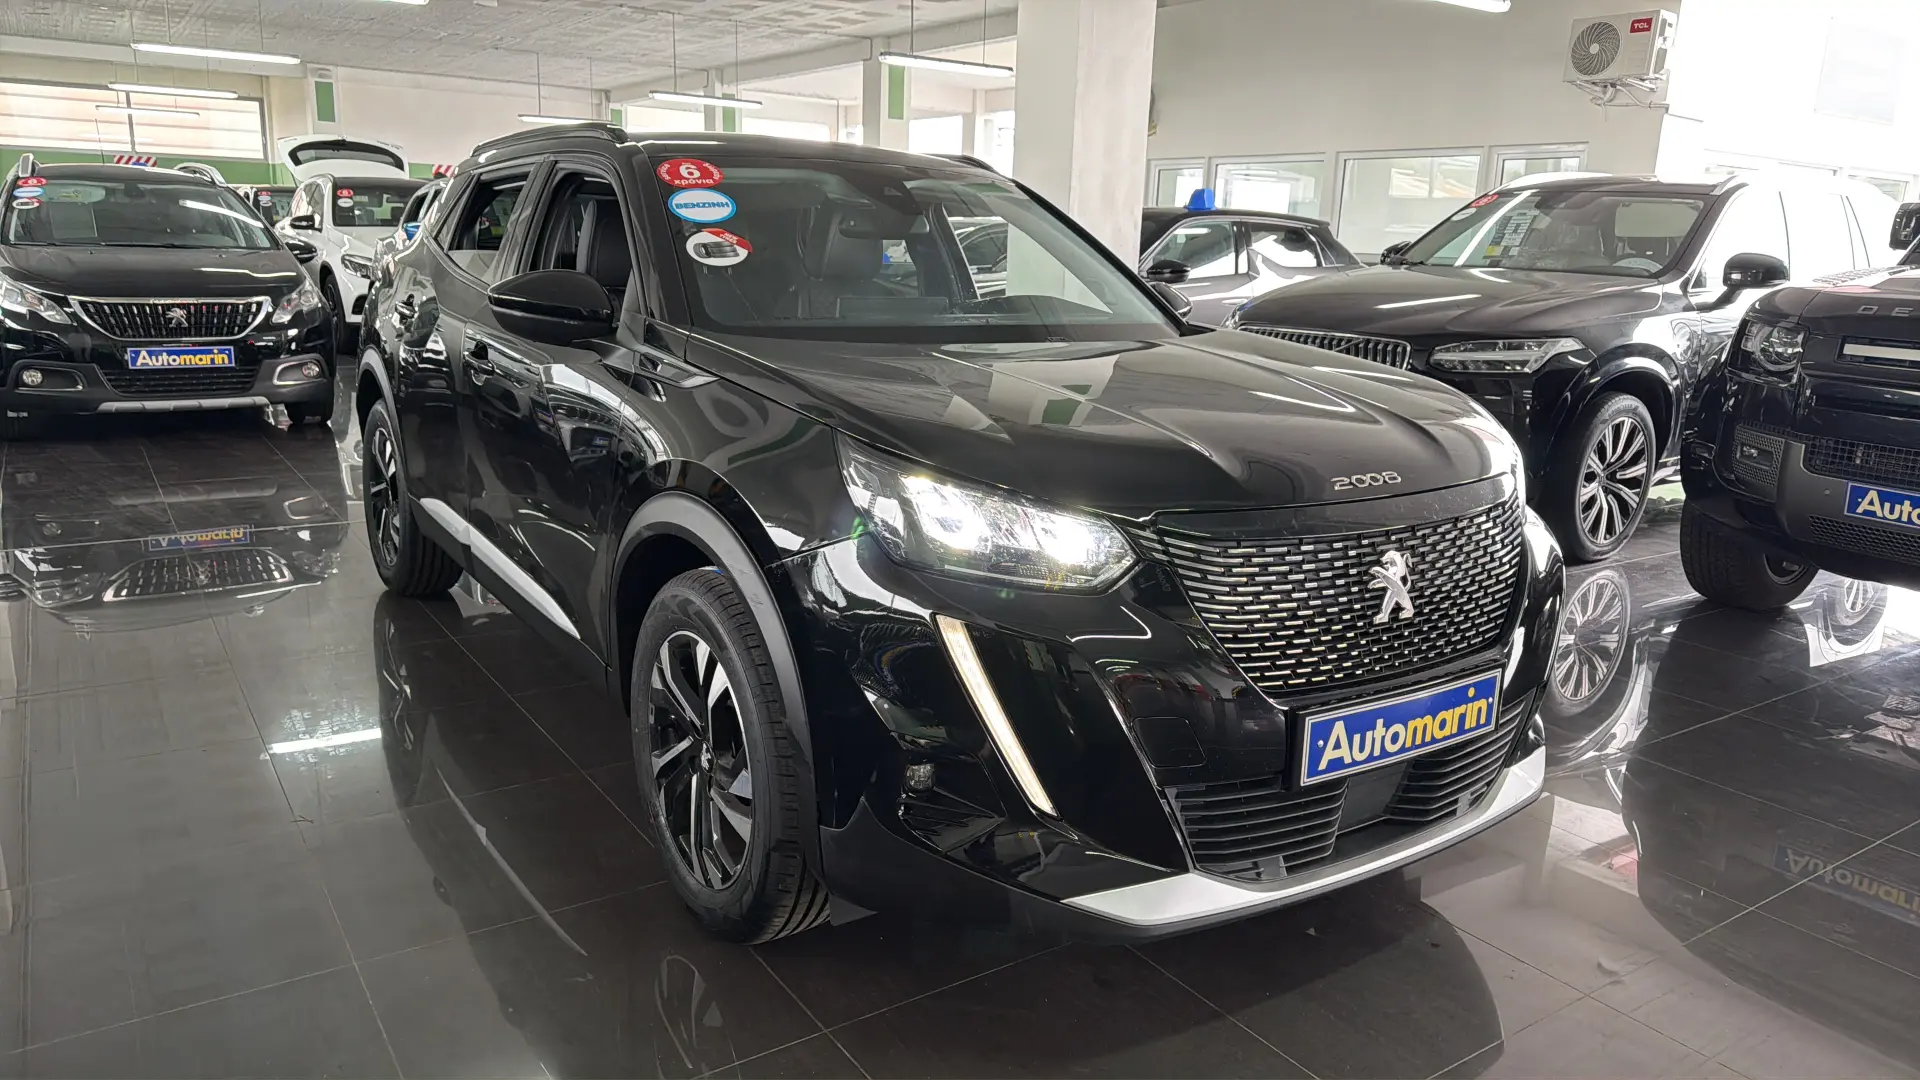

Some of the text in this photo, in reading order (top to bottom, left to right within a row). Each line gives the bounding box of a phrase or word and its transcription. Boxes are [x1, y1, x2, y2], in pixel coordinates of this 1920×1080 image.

[679, 164, 701, 179] 6
[673, 178, 715, 186] χρόνια
[136, 348, 229, 366] Automarin
[1330, 470, 1402, 491] 2008
[1318, 686, 1488, 771] Automarin
